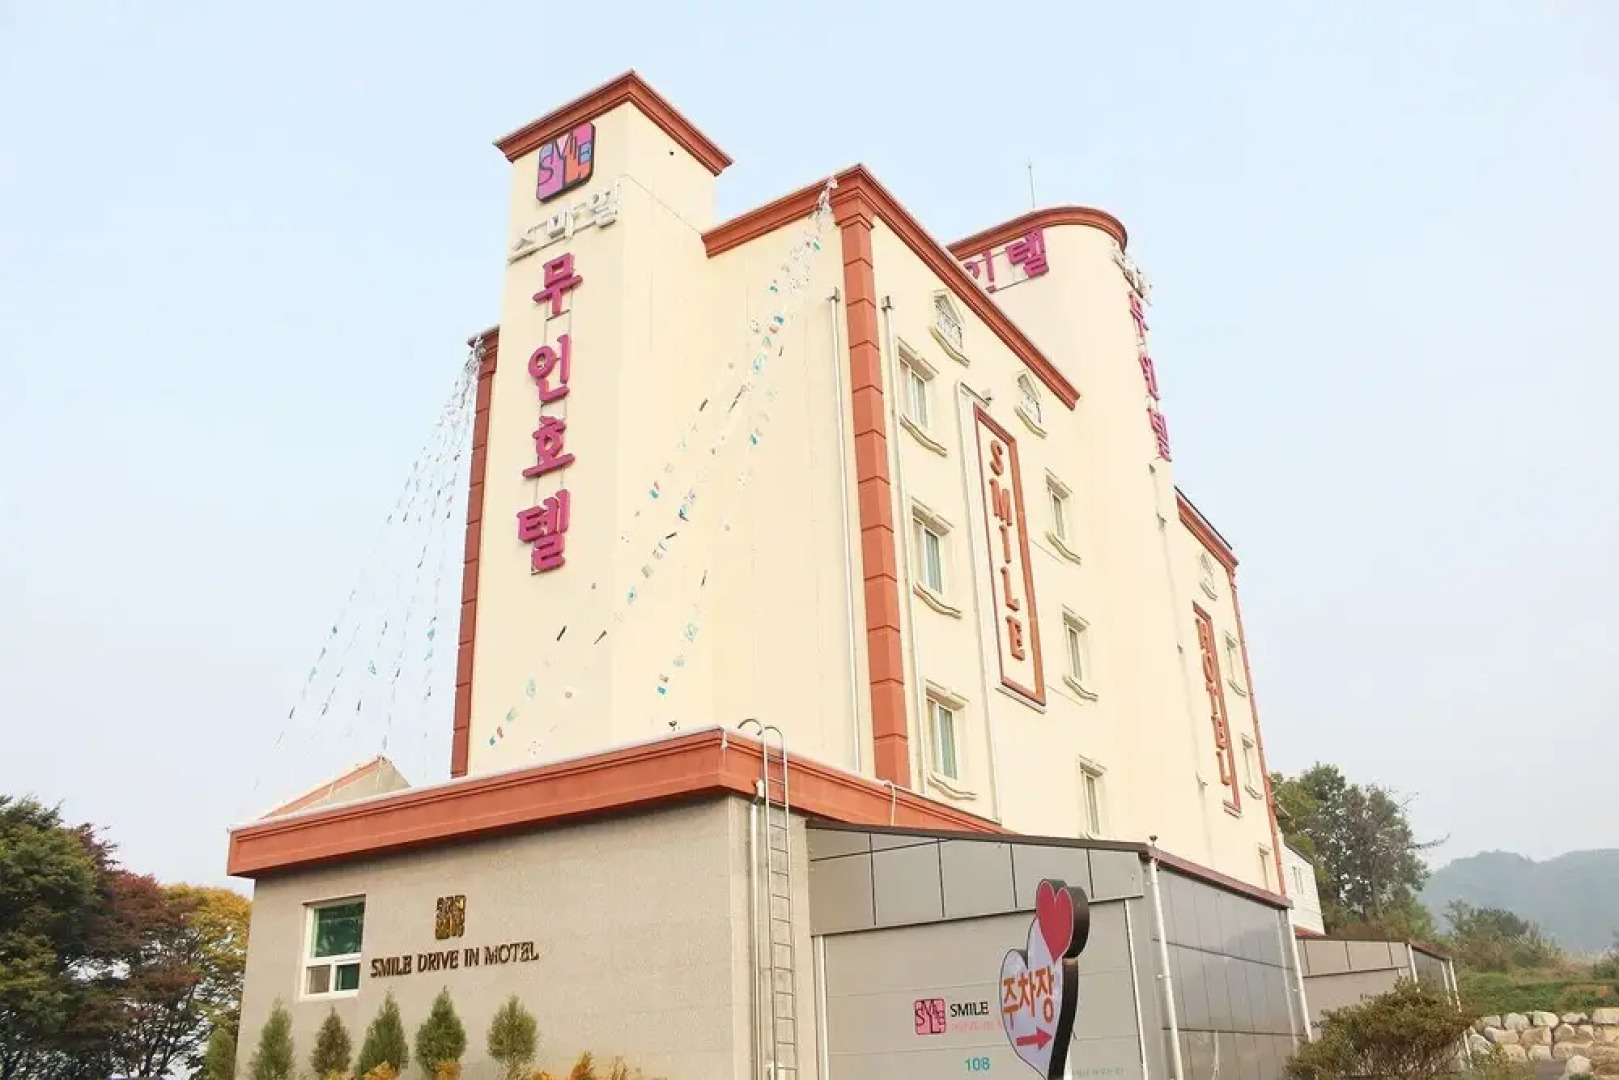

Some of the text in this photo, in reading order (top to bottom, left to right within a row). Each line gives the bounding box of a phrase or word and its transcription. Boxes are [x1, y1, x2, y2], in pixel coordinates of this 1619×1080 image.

[517, 252, 583, 571] 무인호텔
[989, 440, 1025, 661] SMILE
[370, 941, 539, 978] SMILE DRIVE IN MOTEL
[950, 1001, 990, 1018] SMILE
[1002, 966, 1055, 1031] 주차장
[964, 1057, 990, 1072] 108
